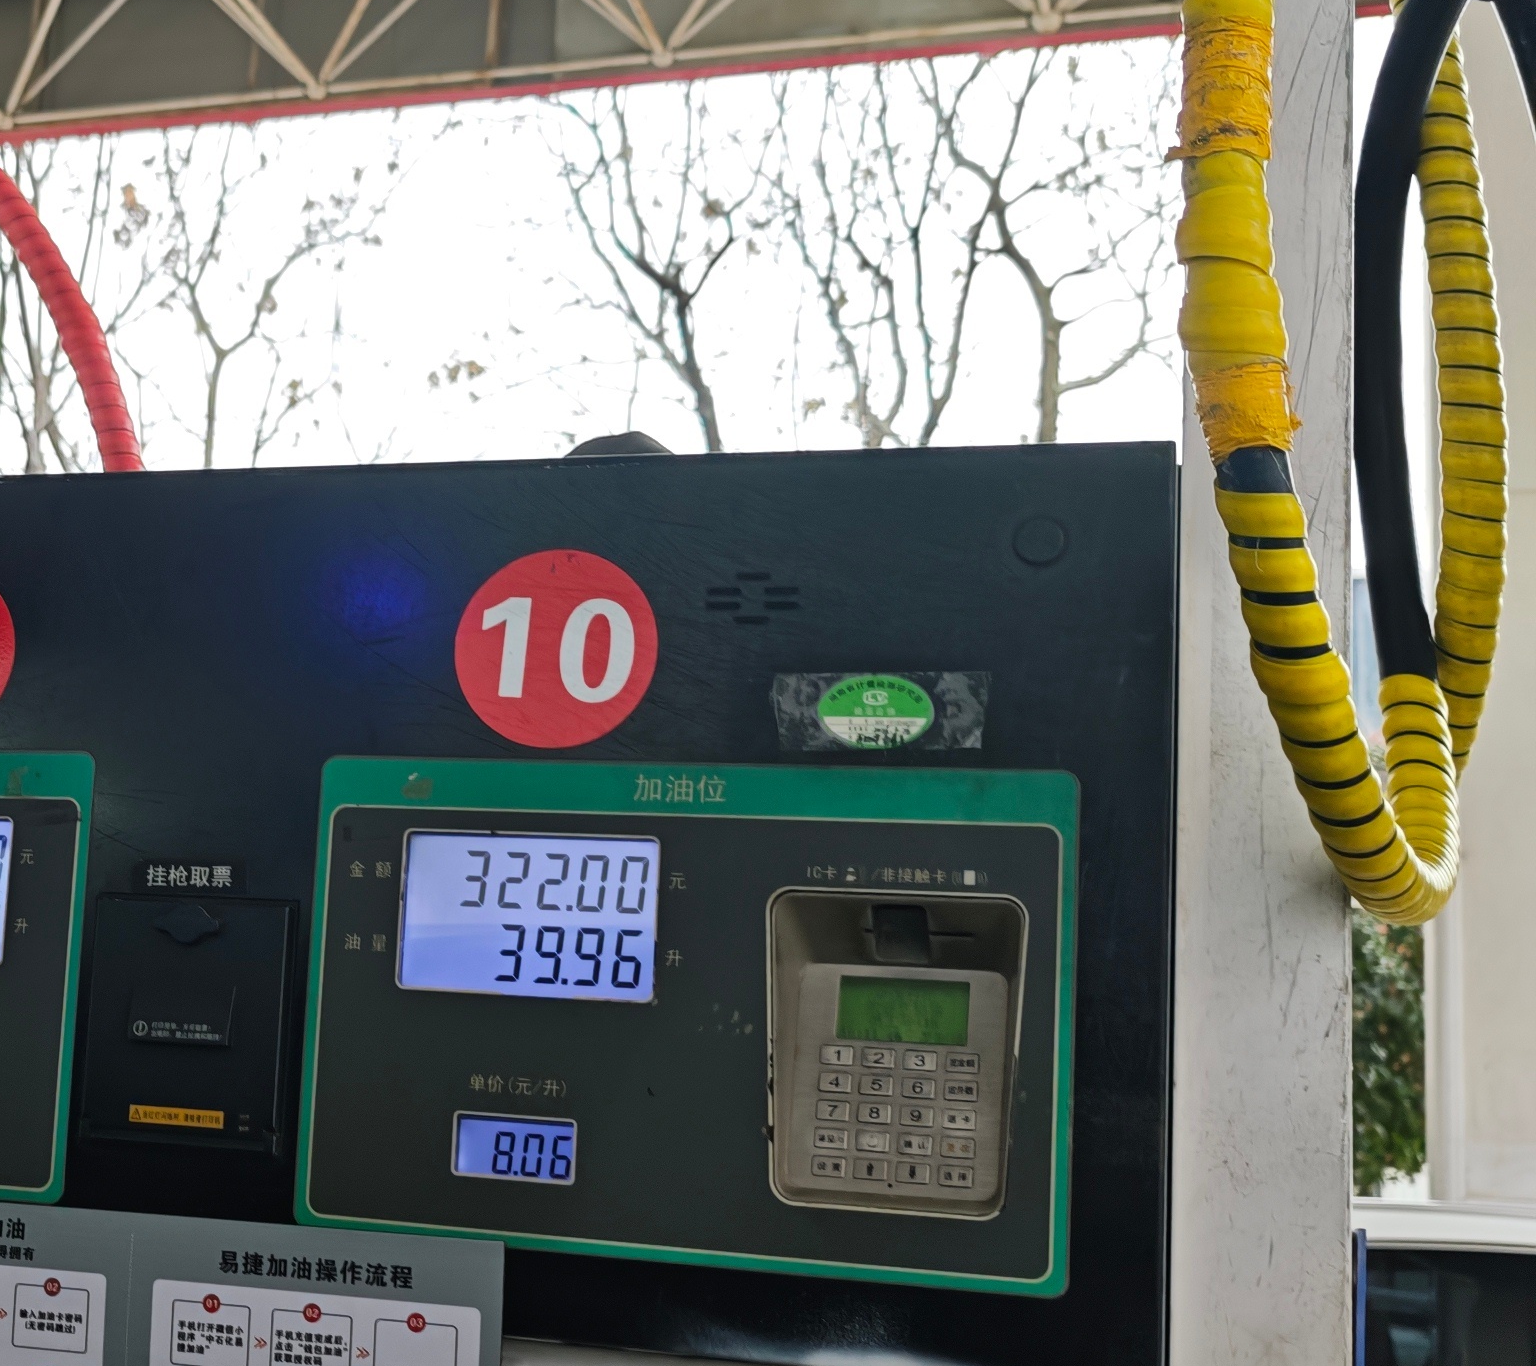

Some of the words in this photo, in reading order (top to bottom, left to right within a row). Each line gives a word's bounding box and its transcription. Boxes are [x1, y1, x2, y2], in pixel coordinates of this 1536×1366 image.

[479, 596, 636, 704] 10
[633, 773, 727, 805] 加油位
[20, 848, 35, 865] 元
[146, 863, 233, 888] 挂枪取票
[459, 849, 652, 916] 322.00
[668, 871, 687, 891] 元
[13, 917, 29, 935] 升
[497, 923, 645, 991] 39.96
[665, 948, 683, 968] 升
[833, 1049, 842, 1062] 1
[873, 1052, 885, 1065] 2
[913, 1054, 926, 1067] 3
[468, 1073, 570, 1100] 单价(元/升)
[828, 1076, 841, 1088] 4
[870, 1078, 883, 1091] 5
[911, 1081, 924, 1094] 6
[827, 1104, 839, 1117] 7
[868, 1106, 881, 1120] 8
[909, 1108, 923, 1122] 9
[491, 1129, 573, 1181] 8.06
[218, 1250, 414, 1290] 易捷加油操作流程
[45, 1282, 59, 1293] 02
[205, 1298, 219, 1309] 01
[305, 1307, 319, 1319] 02
[409, 1317, 424, 1329] 03
